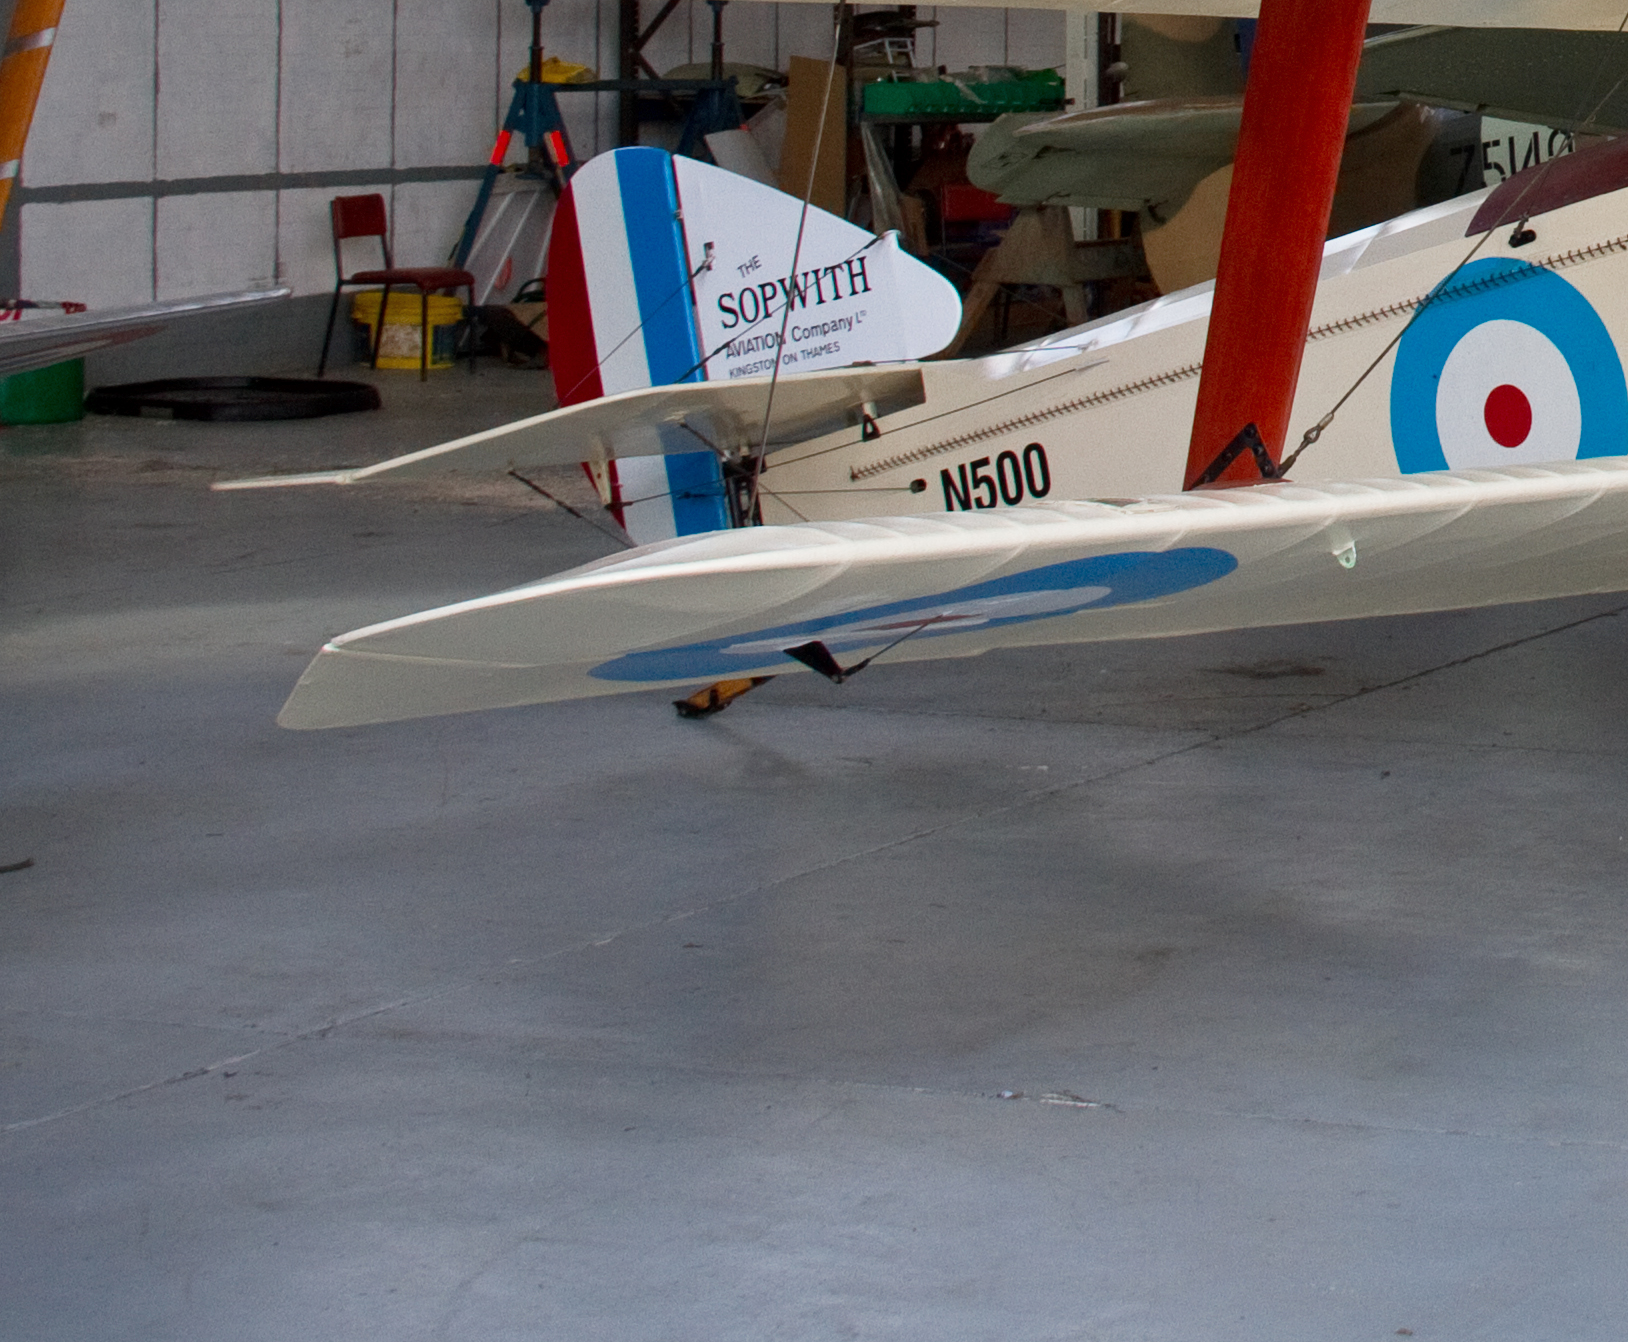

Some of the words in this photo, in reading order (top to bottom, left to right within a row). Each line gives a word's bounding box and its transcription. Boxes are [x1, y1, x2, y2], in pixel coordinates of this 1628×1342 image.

[738, 255, 762, 278] THE
[718, 256, 872, 329] SOPWITH
[726, 331, 786, 359] AVIATION
[791, 314, 854, 343] Company
[729, 360, 776, 379] KINGSTON
[783, 351, 798, 366] ON
[801, 341, 841, 360] THAMES
[940, 442, 1051, 512] N500
